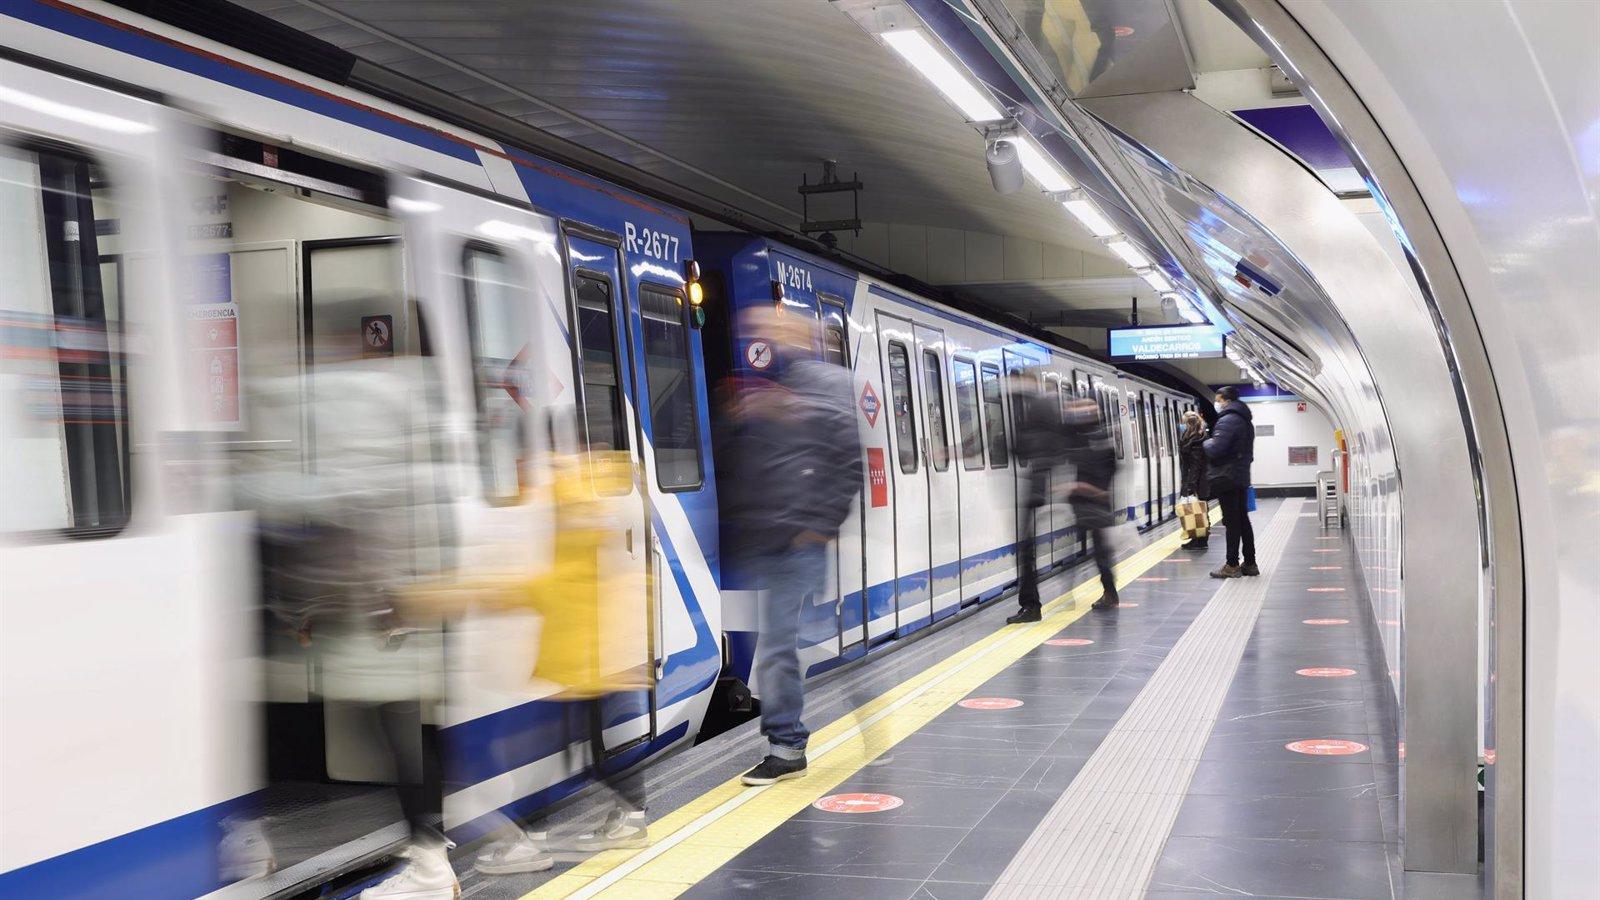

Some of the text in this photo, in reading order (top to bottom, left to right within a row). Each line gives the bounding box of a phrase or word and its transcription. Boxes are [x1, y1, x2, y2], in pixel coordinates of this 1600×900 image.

[624, 221, 679, 263] R-2677
[776, 260, 813, 292] M-2674
[1132, 342, 1201, 353] VALDECARROS
